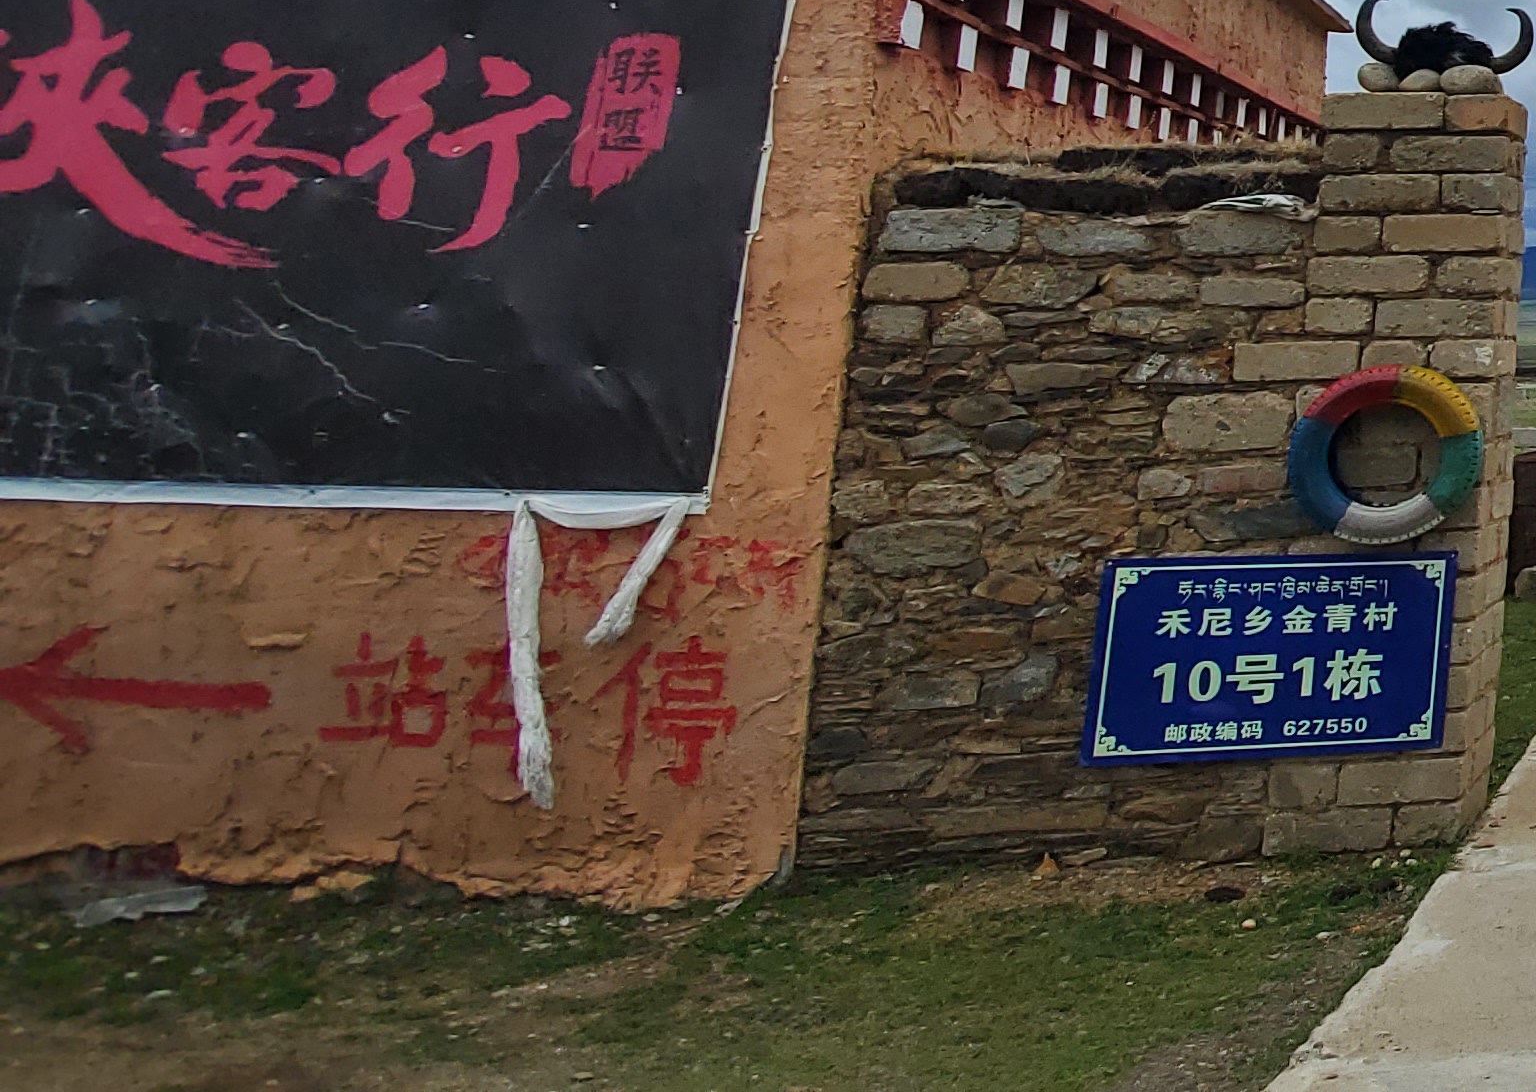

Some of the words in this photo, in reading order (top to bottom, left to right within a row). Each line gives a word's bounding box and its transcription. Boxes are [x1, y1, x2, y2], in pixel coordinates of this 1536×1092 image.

[598, 46, 665, 153] 联盟
[1155, 601, 1399, 639] 禾尼乡金青村
[1152, 648, 1385, 706] 10号1栋
[1164, 718, 1264, 744] 邮政编码
[1282, 716, 1369, 738] 627550
